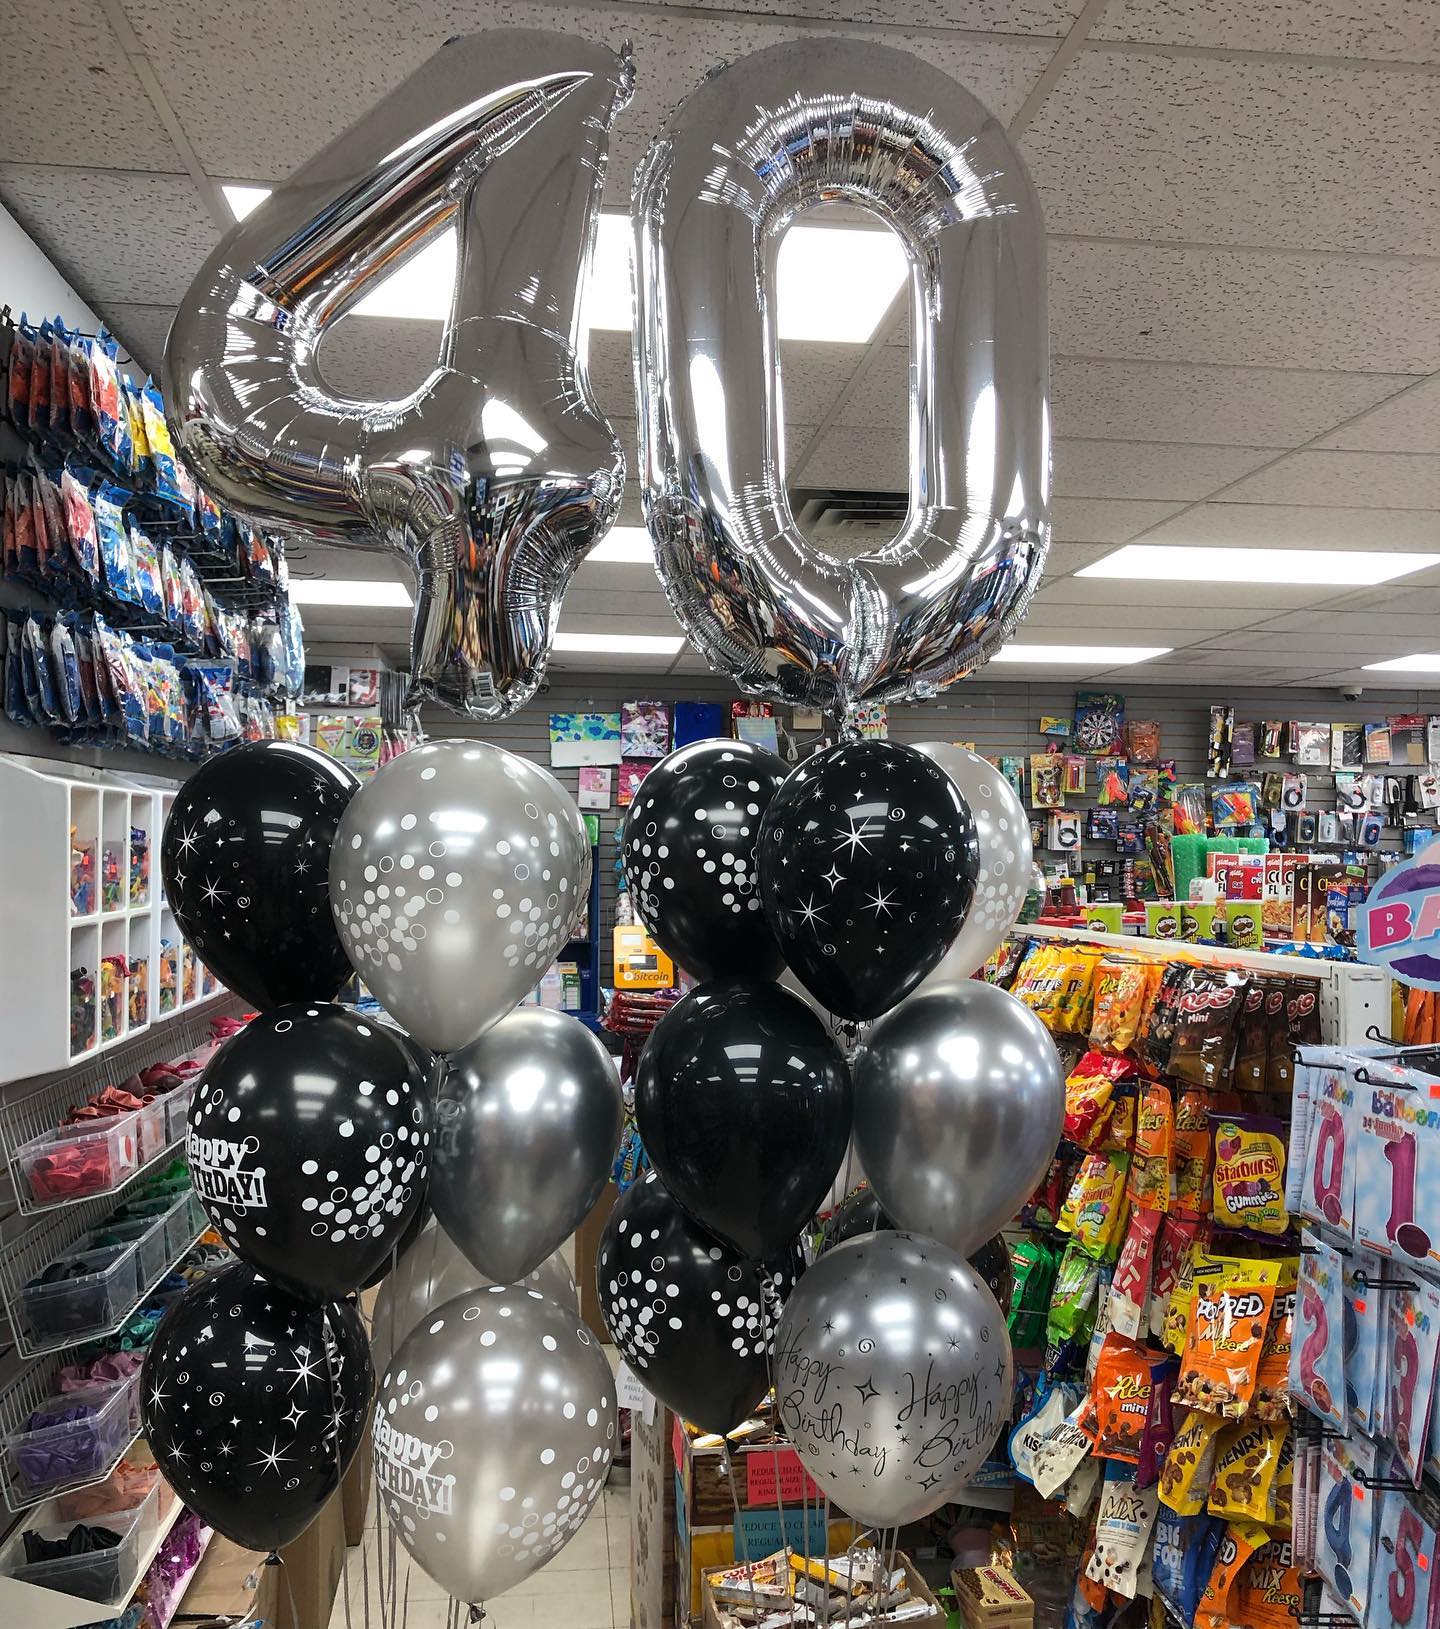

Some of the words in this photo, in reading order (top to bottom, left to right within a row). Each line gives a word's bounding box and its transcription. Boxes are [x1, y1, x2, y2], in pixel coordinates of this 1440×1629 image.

[633, 969, 669, 981] bitcoin
[1216, 1156, 1279, 1183] Starburst
[1197, 1293, 1264, 1322] POPPED
[776, 1322, 845, 1404] Happy
[897, 1359, 985, 1421] Happy
[373, 1401, 442, 1479] Happy
[781, 1389, 889, 1477] Birthday
[1101, 1496, 1144, 1522] MIX
[742, 1520, 777, 1531] EDUCE
[793, 1519, 825, 1529] CLAR
[1156, 1522, 1181, 1547] BIG
[1153, 1544, 1184, 1570] FOOT
